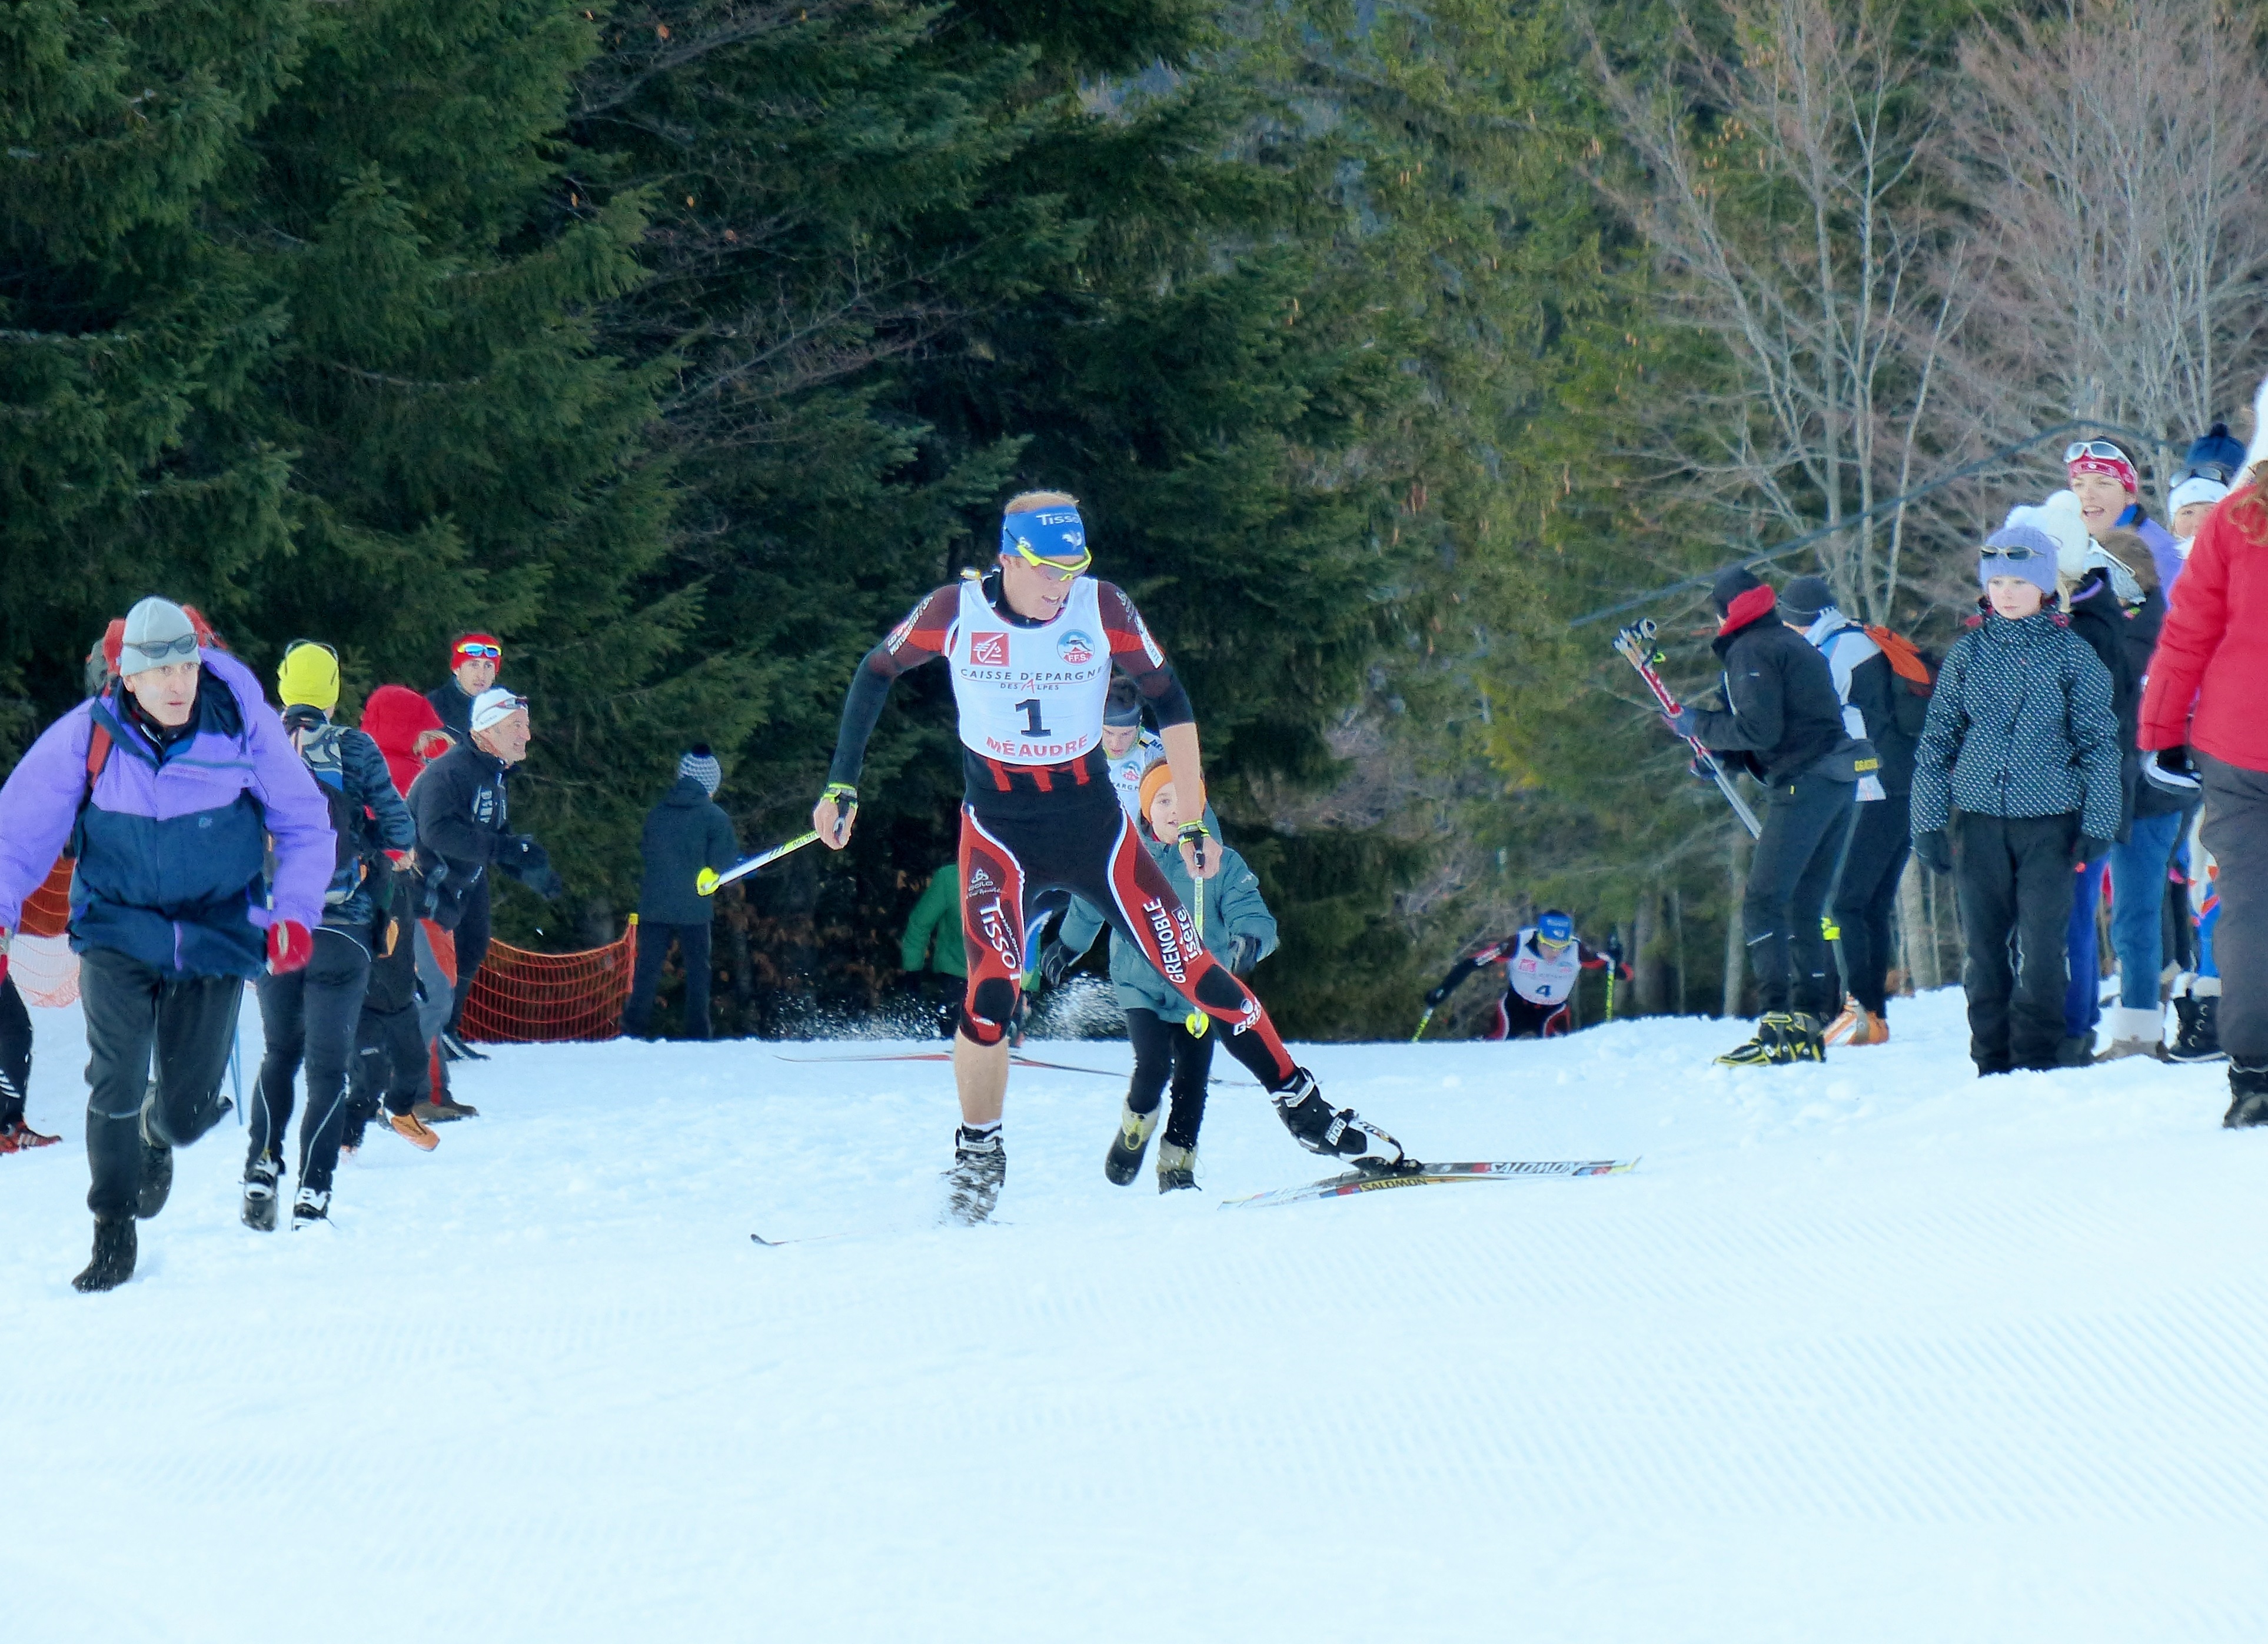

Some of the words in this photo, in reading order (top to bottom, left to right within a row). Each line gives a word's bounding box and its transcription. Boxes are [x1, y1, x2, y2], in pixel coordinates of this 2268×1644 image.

[961, 668, 1012, 680] CAISSE
[1020, 665, 1103, 681] D'EPARGNE
[1020, 678, 1059, 694] ALPES
[1015, 698, 1052, 738] 1
[986, 733, 1088, 757] MÉAUDRE
[980, 896, 1022, 981] TISSOT
[1143, 896, 1186, 983] GRENOBLE
[1178, 908, 1199, 962] isère
[1535, 984, 1551, 997] 4
[1491, 1162, 1581, 1174] SALOMON
[1361, 1177, 1427, 1192] SALOMON
